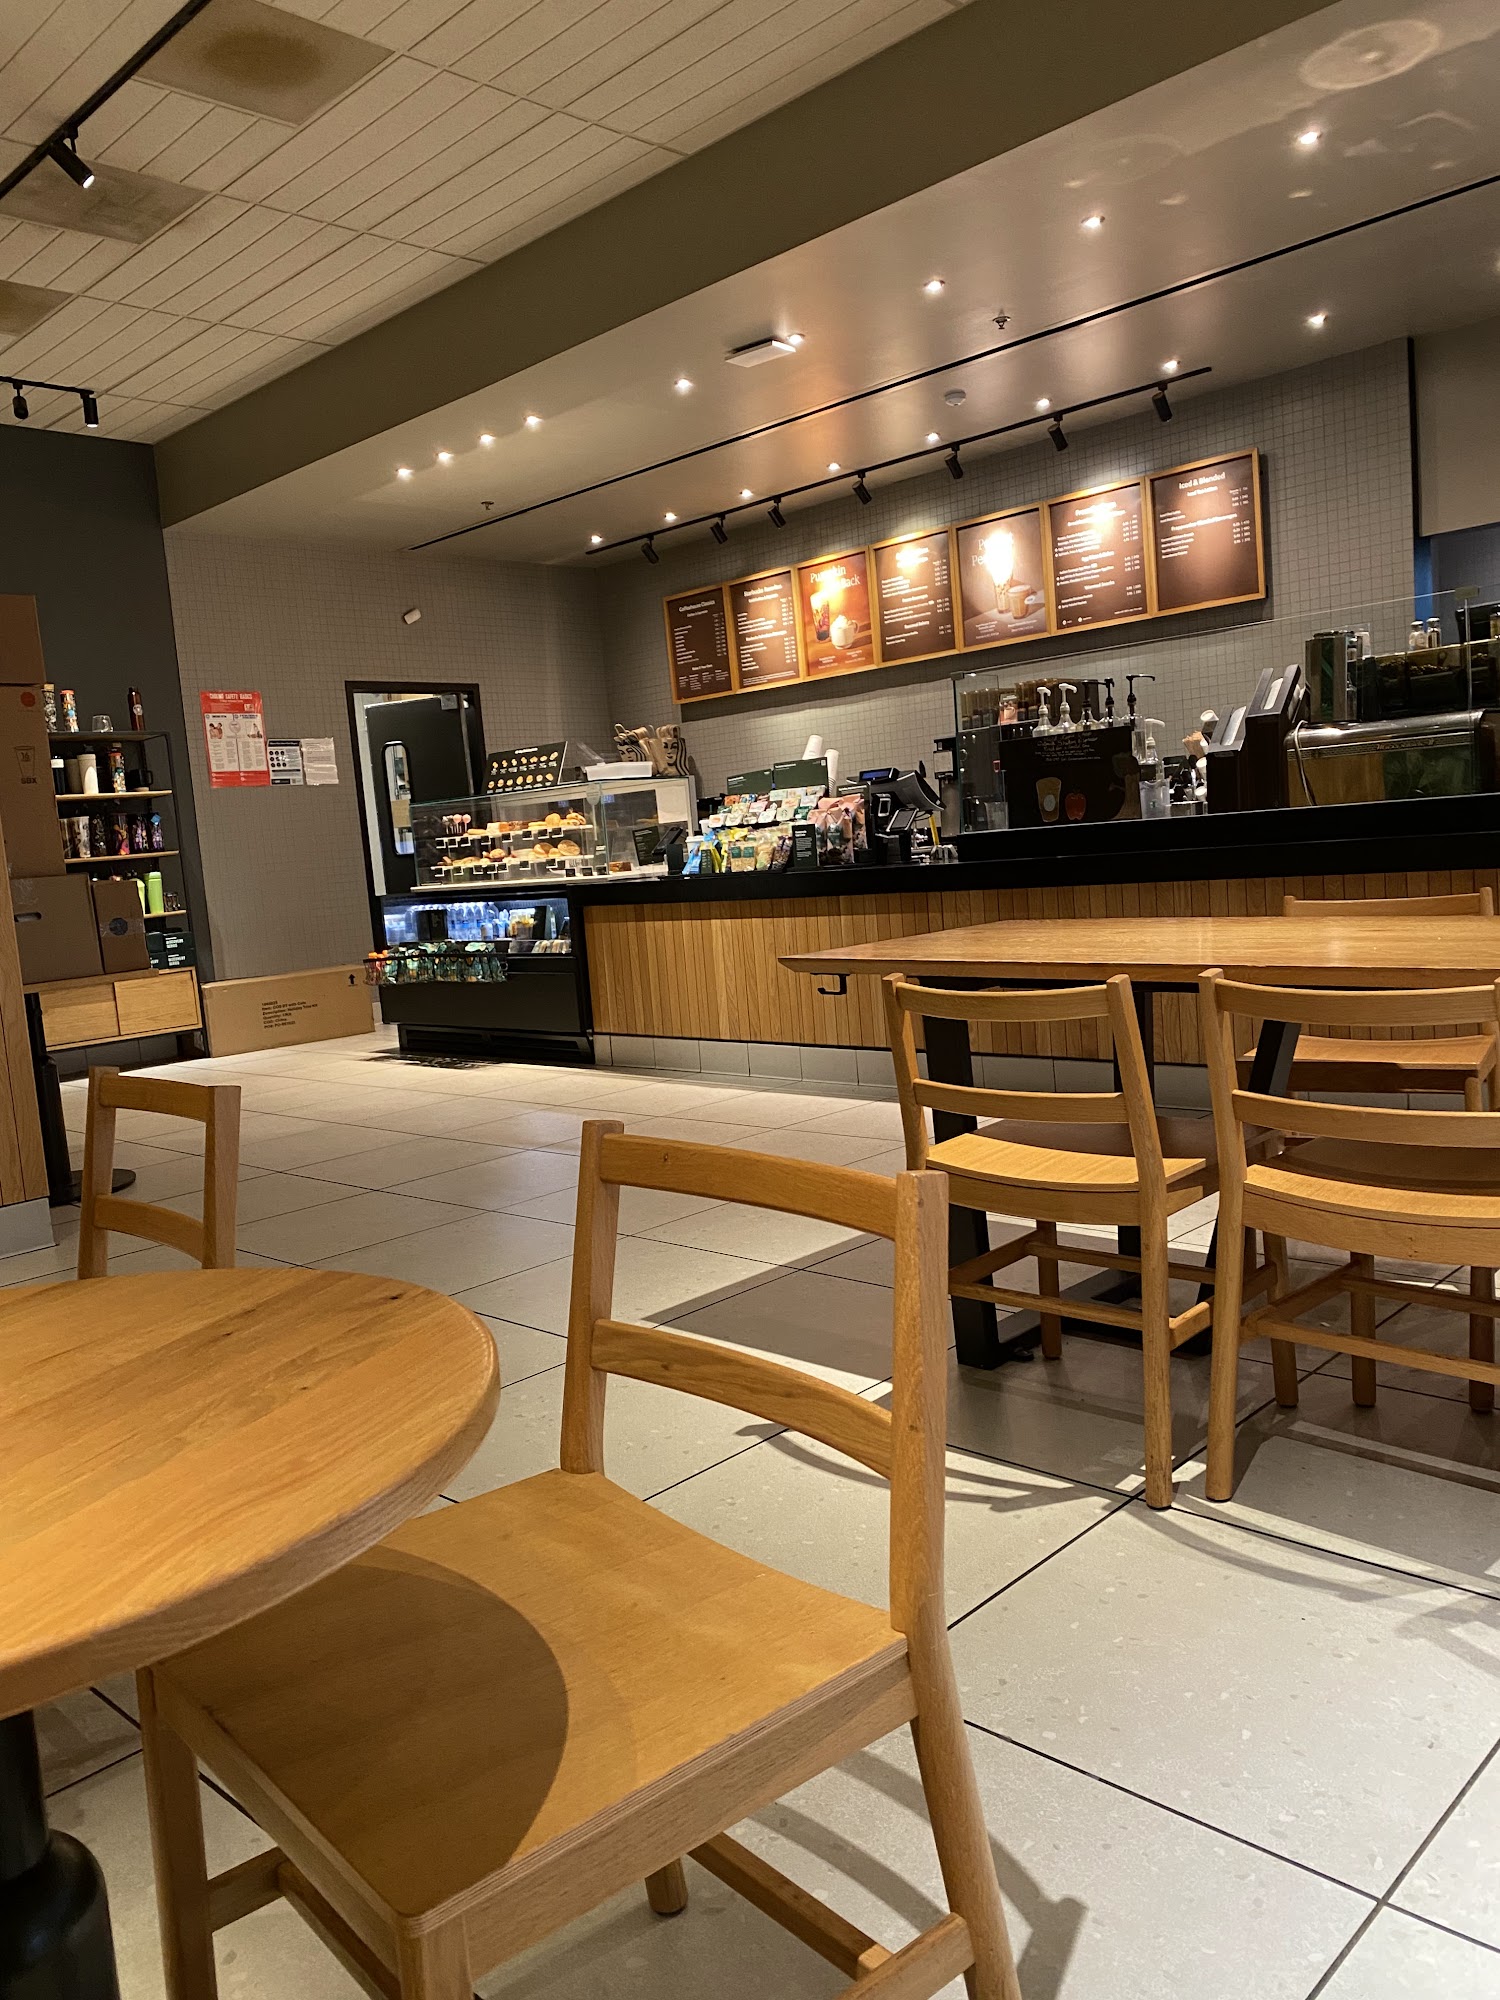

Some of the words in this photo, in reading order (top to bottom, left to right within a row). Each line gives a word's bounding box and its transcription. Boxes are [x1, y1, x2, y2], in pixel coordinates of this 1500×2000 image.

[1179, 479, 1193, 489] Iced
[1193, 478, 1198, 486] &
[1199, 471, 1226, 485] Blended
[810, 565, 846, 583] Pukin
[20, 752, 30, 760] 16
[20, 777, 37, 785] SBX
